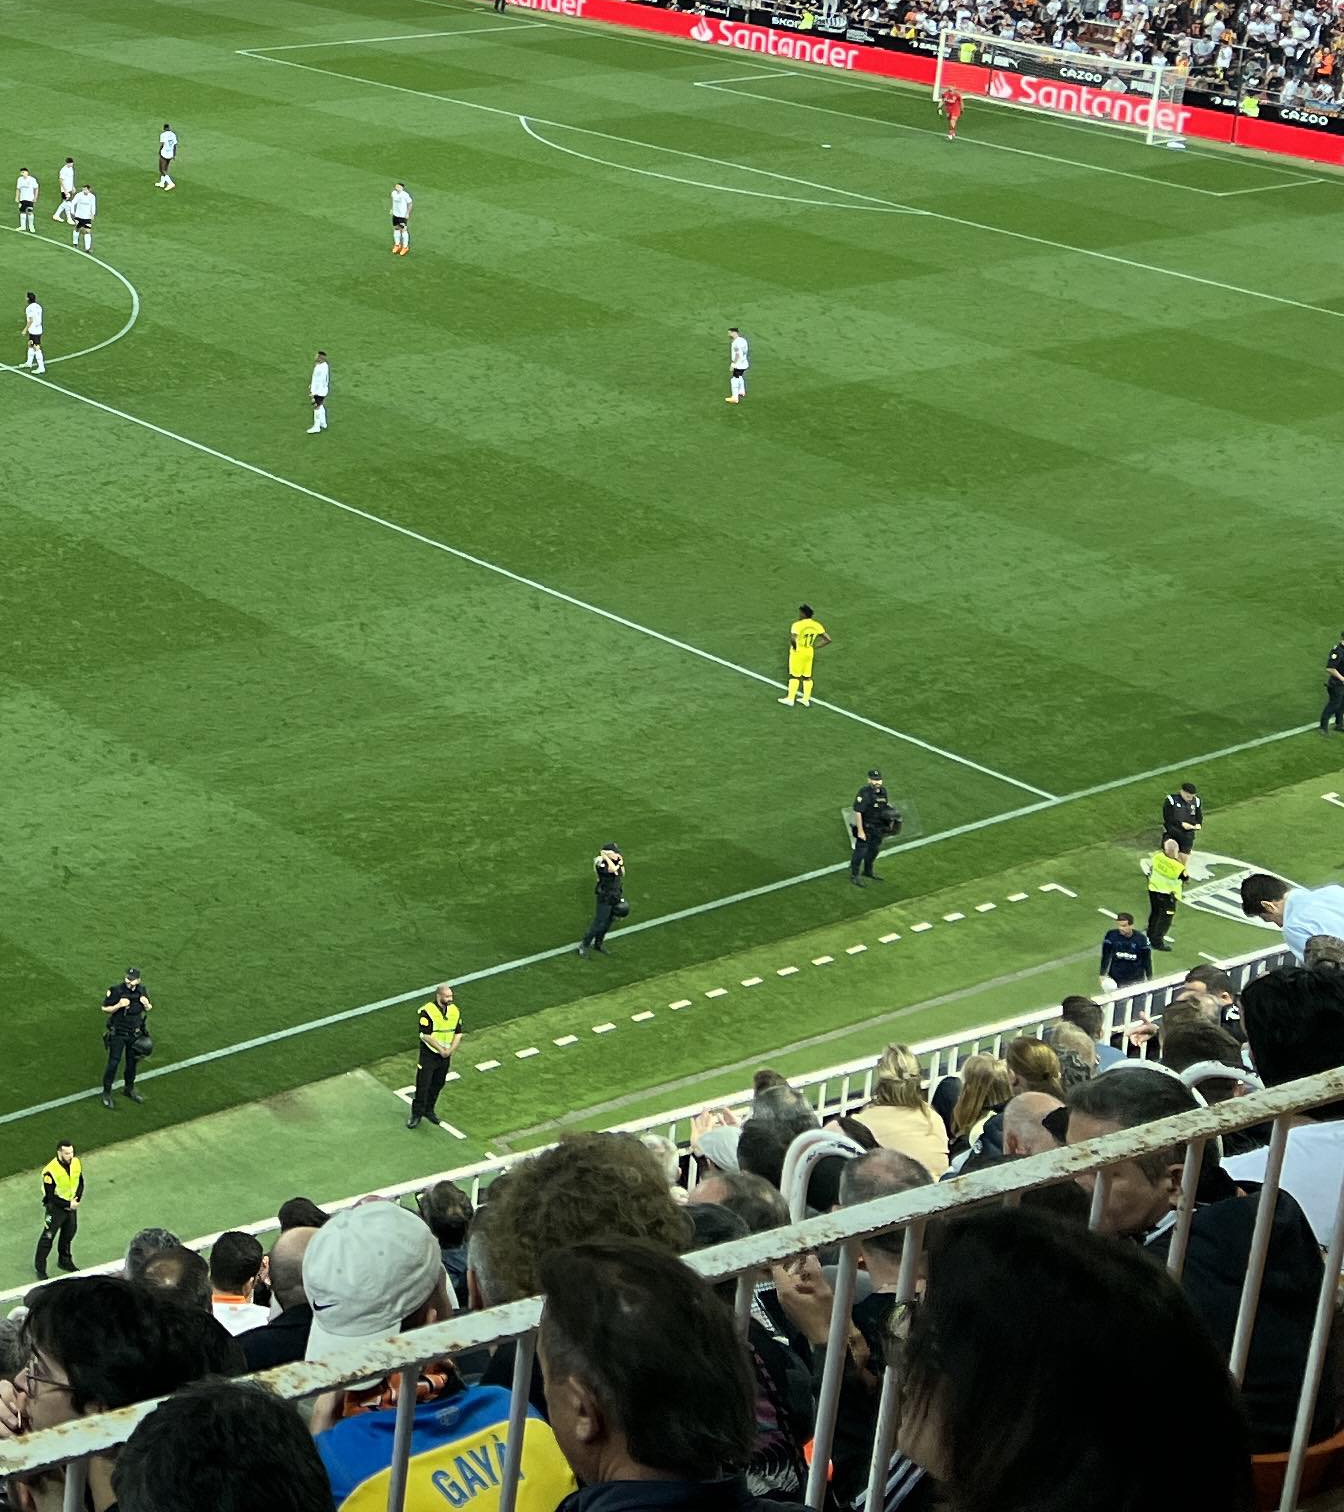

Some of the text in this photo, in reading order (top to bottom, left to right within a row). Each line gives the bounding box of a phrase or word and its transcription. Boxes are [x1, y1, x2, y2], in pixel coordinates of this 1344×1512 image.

[718, 20, 859, 70] Santander
[1060, 67, 1102, 83] CAZOO
[1019, 76, 1191, 134] Santander
[1280, 109, 1328, 126] CAZOO
